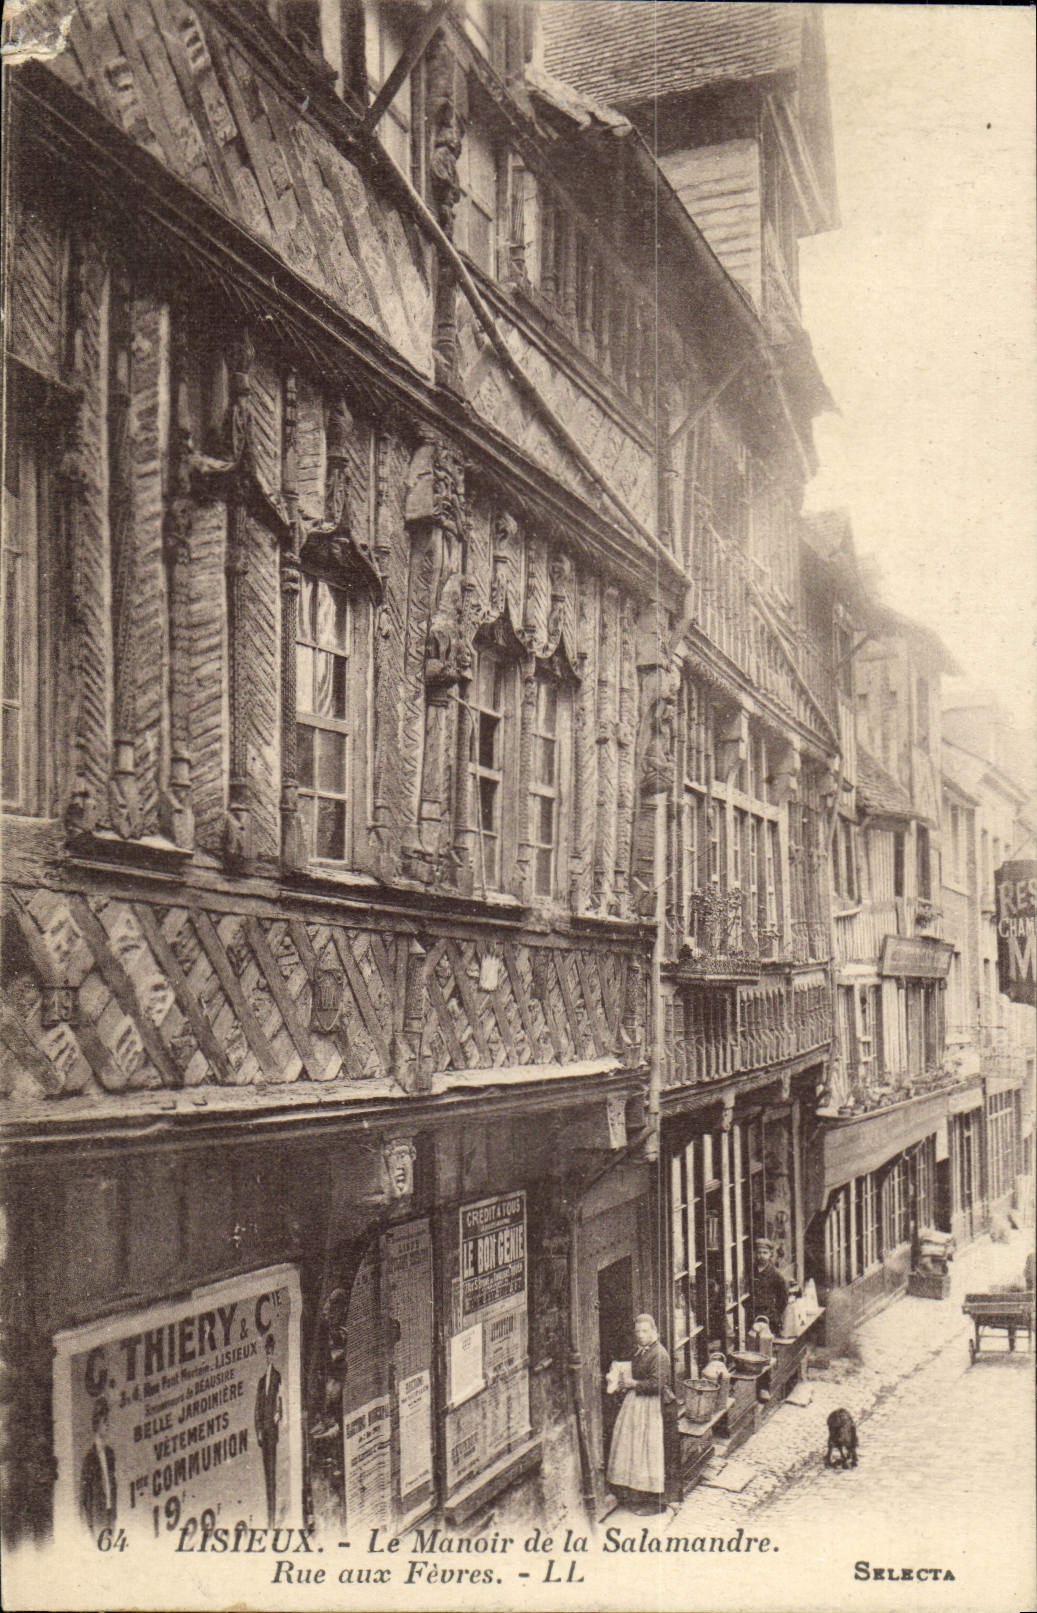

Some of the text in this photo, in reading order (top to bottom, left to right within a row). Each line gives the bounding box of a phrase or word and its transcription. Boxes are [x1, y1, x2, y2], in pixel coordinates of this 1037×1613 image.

[502, 1197, 520, 1216] TOUS
[463, 1240, 475, 1279] LE
[477, 1233, 496, 1273] BON
[120, 1302, 238, 1382] THIERY
[240, 1318, 249, 1341] &
[215, 1342, 258, 1370] LISIEUX
[194, 1368, 236, 1396] BEAUSIRE
[133, 1412, 173, 1442] BELLE
[152, 1428, 248, 1497] COMMUNION
